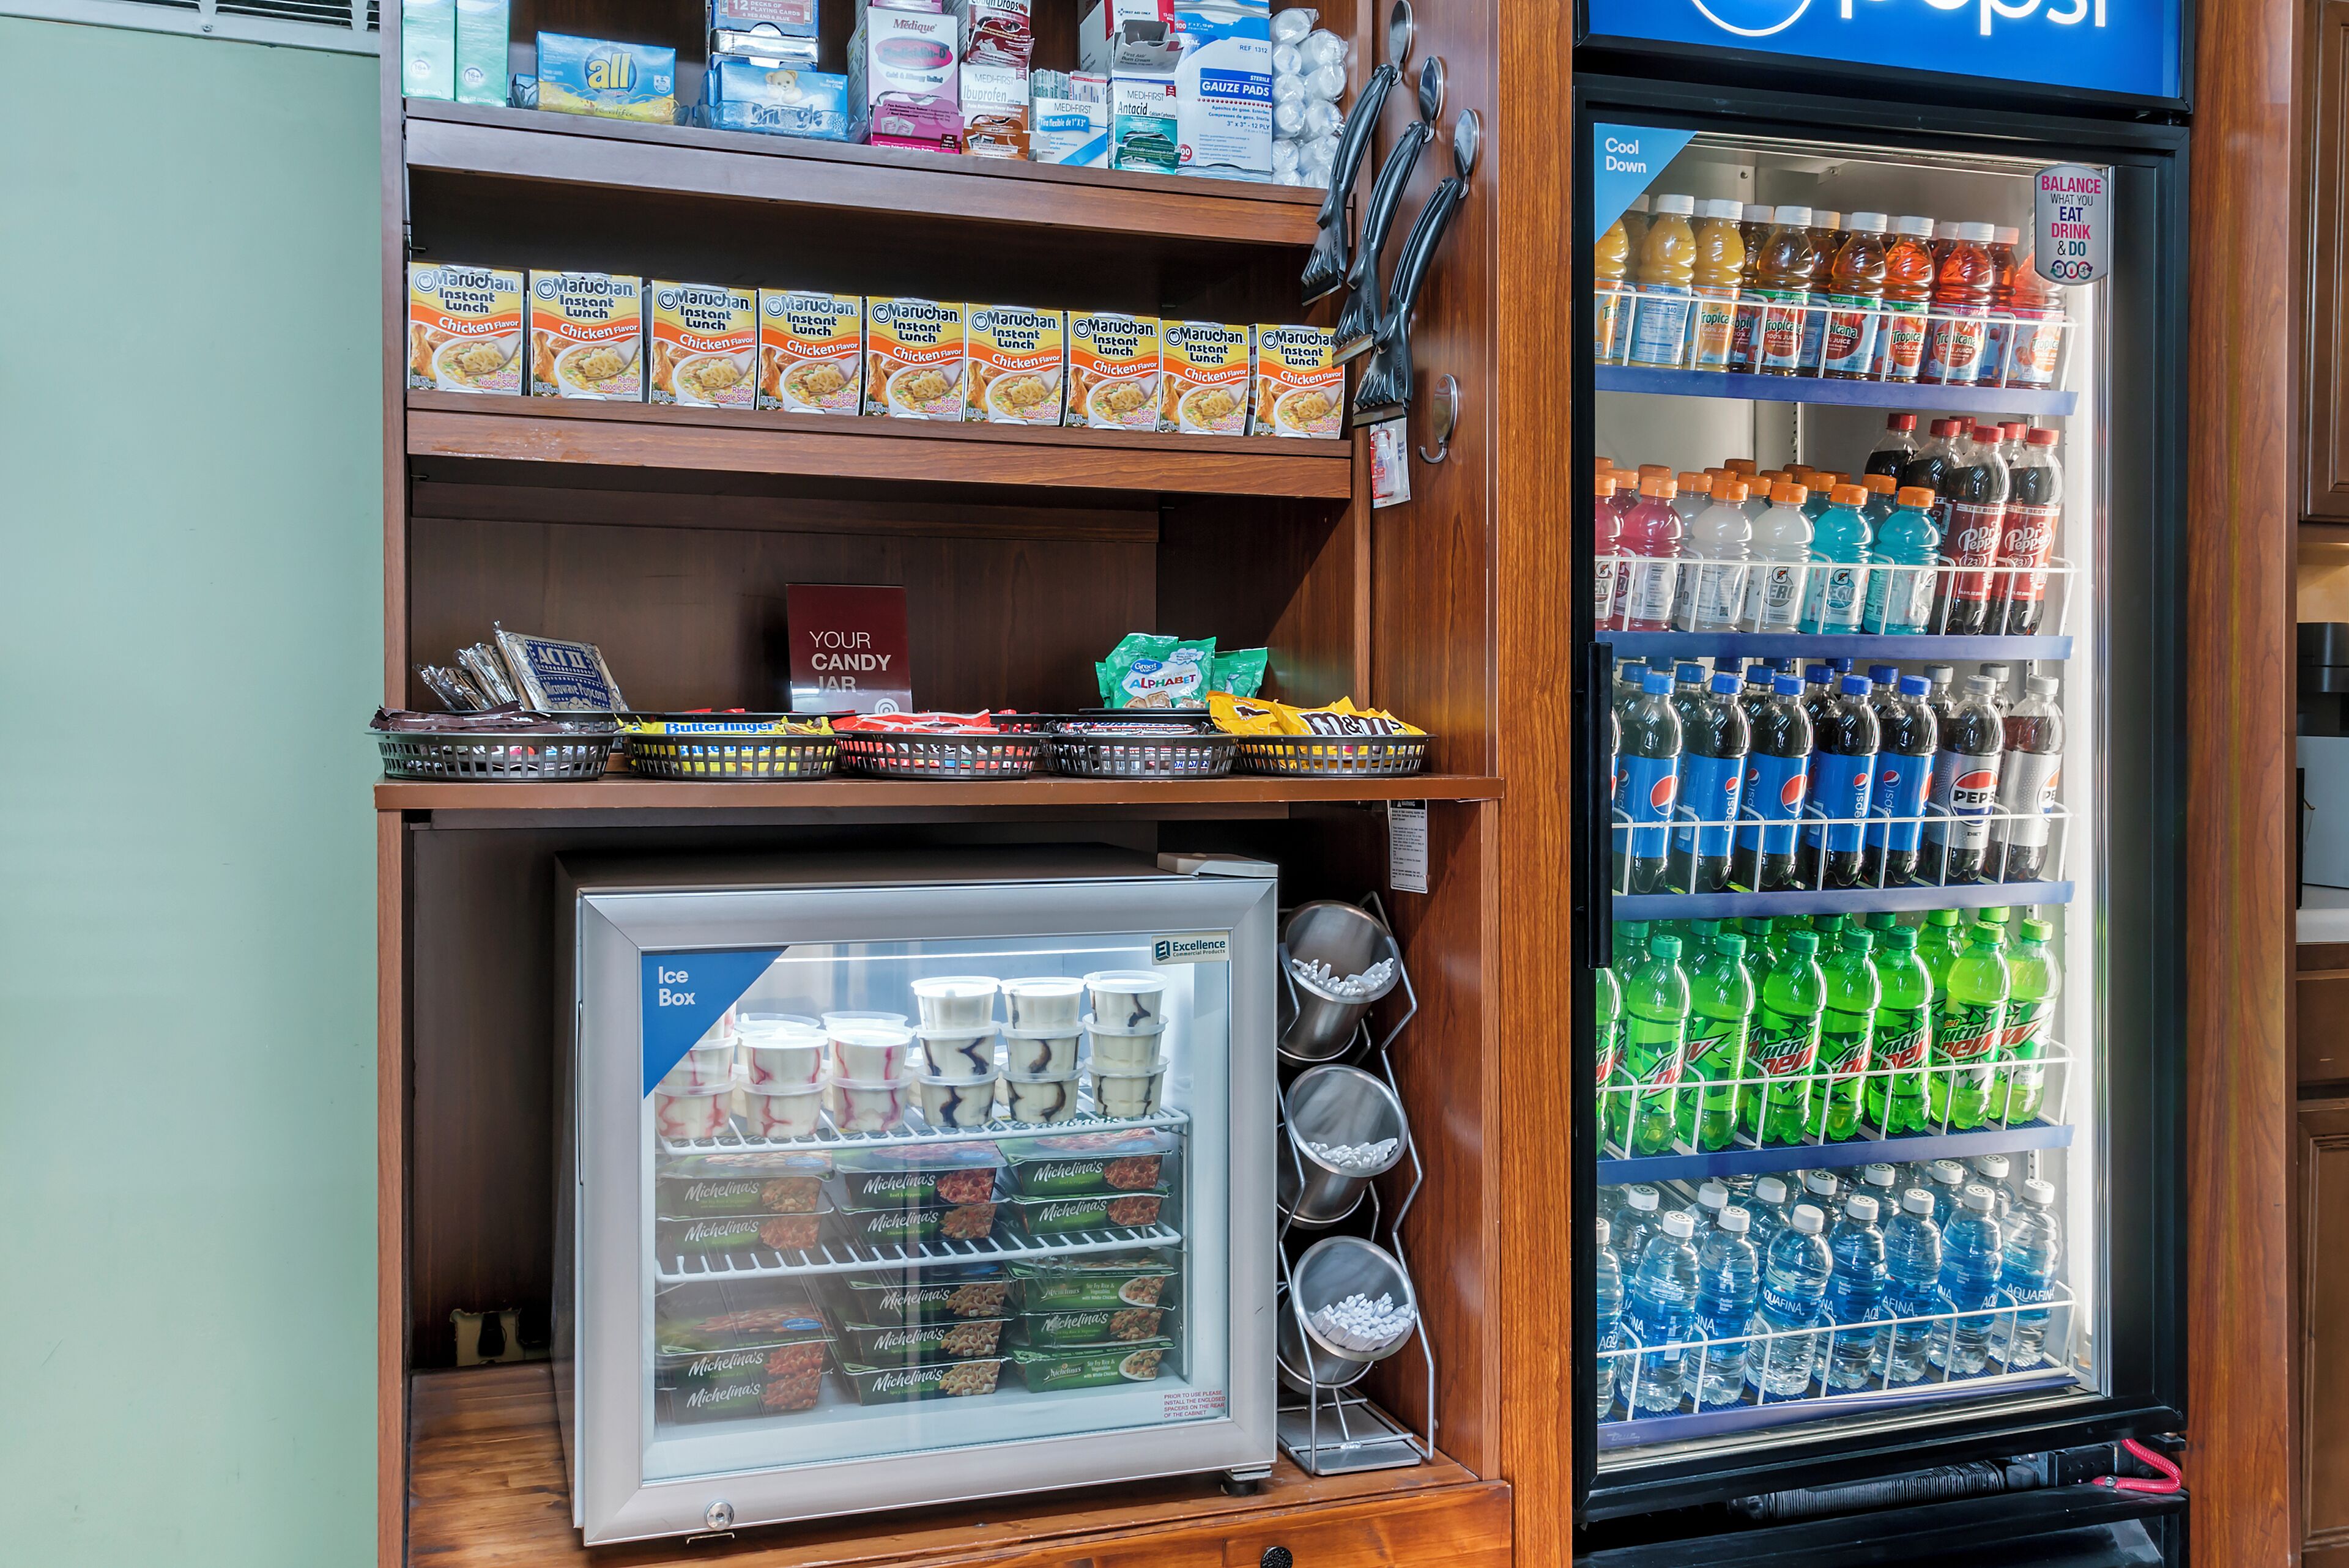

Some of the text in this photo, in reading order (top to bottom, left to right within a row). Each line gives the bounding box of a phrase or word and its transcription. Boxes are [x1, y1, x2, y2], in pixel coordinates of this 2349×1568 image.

[733, 0, 748, 10] 12
[751, 6, 778, 15] PLAYING
[1841, 0, 2106, 36] psi
[467, 70, 480, 80] 16+
[588, 53, 633, 89] all
[1250, 75, 1270, 83] STERILE
[974, 73, 1014, 86] MEDI-FIRST
[963, 85, 1007, 103] Ibuprofen
[1127, 90, 1164, 102] MEDI-FIRST
[1202, 81, 1270, 97] GAUZE PADS
[1054, 102, 1091, 114] MEDI-FIRST
[1118, 101, 1148, 116] Antacid
[1605, 138, 1639, 155] Cool
[1606, 155, 1647, 173] Down
[2041, 176, 2101, 194] BALANCE
[2050, 193, 2093, 206] WHAT YOU
[2060, 206, 2084, 224] EAT,
[2052, 223, 2091, 240] DRINK
[2057, 240, 2086, 257] & DO
[434, 270, 515, 292] Maruchan
[554, 277, 635, 297] Maruchan
[439, 287, 495, 303] Instant
[559, 294, 614, 308] Instant
[675, 289, 750, 311] Maruchan
[445, 301, 489, 314] Lunch
[565, 306, 609, 319] Lunch
[680, 306, 732, 320] Instant
[782, 295, 856, 316] Maruchan
[888, 303, 959, 323] Maruchan
[438, 316, 519, 334] Chicken Flavor
[685, 317, 726, 331] Lunch
[787, 311, 837, 326] Instant
[893, 319, 941, 333] Instant
[987, 311, 1058, 330] Maruchan
[1088, 317, 1154, 336] Maruchan
[560, 323, 638, 339] Chicken Flavor
[792, 324, 832, 336] Lunch
[899, 331, 937, 343] Lunch
[992, 326, 1040, 339] Instant
[1179, 326, 1244, 345] Maruchan
[679, 333, 754, 351] Chicken Flavor
[787, 339, 858, 357] Chicken Flavor
[997, 338, 1035, 350] Lunch
[1093, 333, 1138, 347] Instant
[1184, 341, 1228, 354] Instant
[892, 346, 962, 362] Chicken Flavor
[1098, 344, 1134, 357] Lunch
[1190, 352, 1225, 364] Lunch
[1280, 344, 1324, 357] Instant
[992, 353, 1060, 369] Chicken Flavor
[1093, 360, 1157, 375] Chicken Flavor
[1285, 355, 1319, 367] Lunch
[1184, 368, 1247, 383] Chicken Flavor
[1280, 370, 1341, 385] Chicken Flavor
[715, 393, 735, 401] Noodle
[732, 386, 752, 395] Ramen
[2025, 525, 2043, 539] Dr
[2005, 529, 2049, 553] Pepper
[1967, 558, 1978, 566] 23
[809, 631, 871, 649] YOUR
[538, 646, 587, 668] ACT II
[811, 653, 892, 671] CANDY
[1129, 674, 1197, 689] ALPHABET
[544, 682, 607, 703] Microwave Popcorn
[665, 722, 774, 734] Butterfinger
[1953, 790, 1995, 804] PEPS
[1173, 939, 1226, 952] Excellence
[658, 966, 689, 985] Ice
[659, 988, 696, 1007] Box
[1943, 1019, 1959, 1028] diet
[1034, 1160, 1103, 1182] Michelina's
[685, 1180, 759, 1202] Michelina's
[864, 1174, 936, 1194] Michelina's
[1039, 1199, 1107, 1222] Michelina's
[867, 1210, 939, 1232] Michelina's
[880, 1288, 950, 1310] Michelina's
[874, 1327, 944, 1350] Michelina's
[688, 1351, 763, 1377] Michelina's
[873, 1369, 943, 1392] Michelina's
